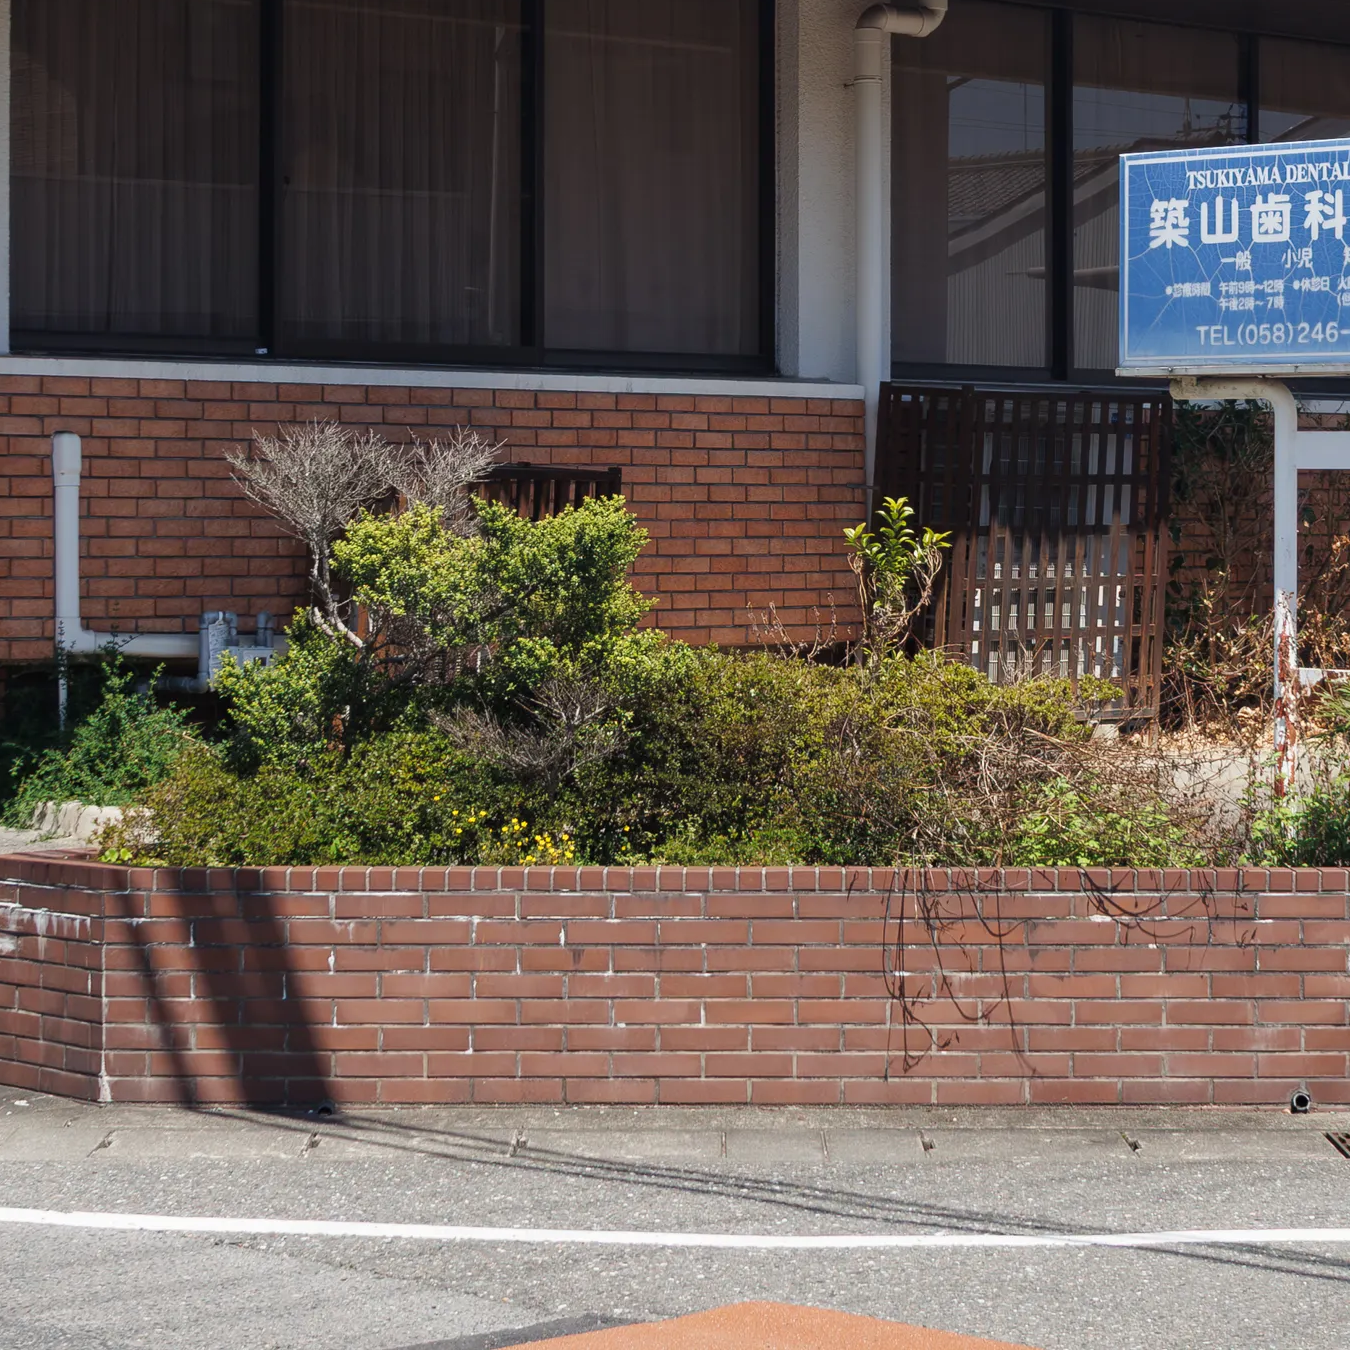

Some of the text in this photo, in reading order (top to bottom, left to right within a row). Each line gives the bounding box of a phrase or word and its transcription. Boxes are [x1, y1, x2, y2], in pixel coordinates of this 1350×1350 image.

[1186, 164, 1282, 189] TSUKIYAMA
[1221, 250, 1252, 271] 一般
[1282, 247, 1313, 268] 小児
